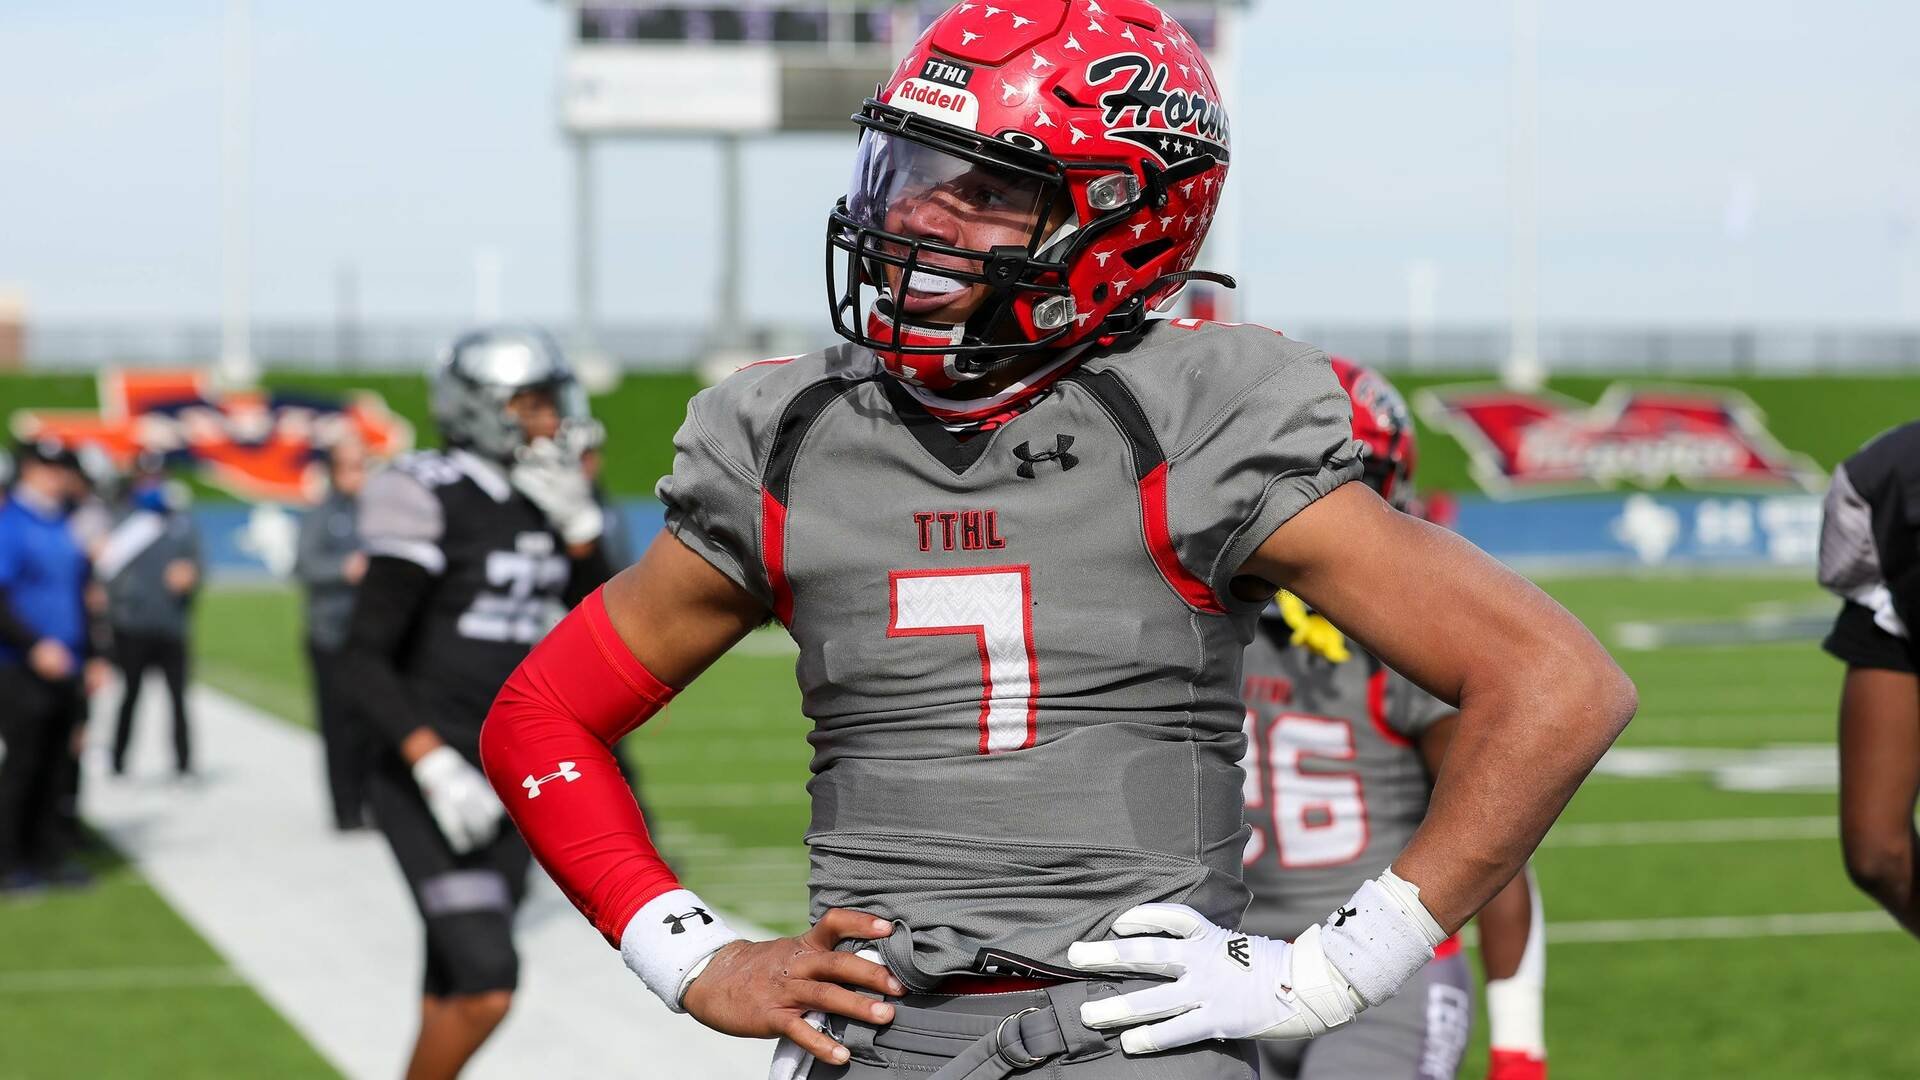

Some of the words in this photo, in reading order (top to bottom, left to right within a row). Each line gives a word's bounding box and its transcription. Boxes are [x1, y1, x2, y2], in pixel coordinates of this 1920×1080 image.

[924, 60, 968, 87] TTHL
[899, 80, 967, 113] Riddell
[914, 509, 1007, 551] TTHL
[887, 563, 1041, 755] 7
